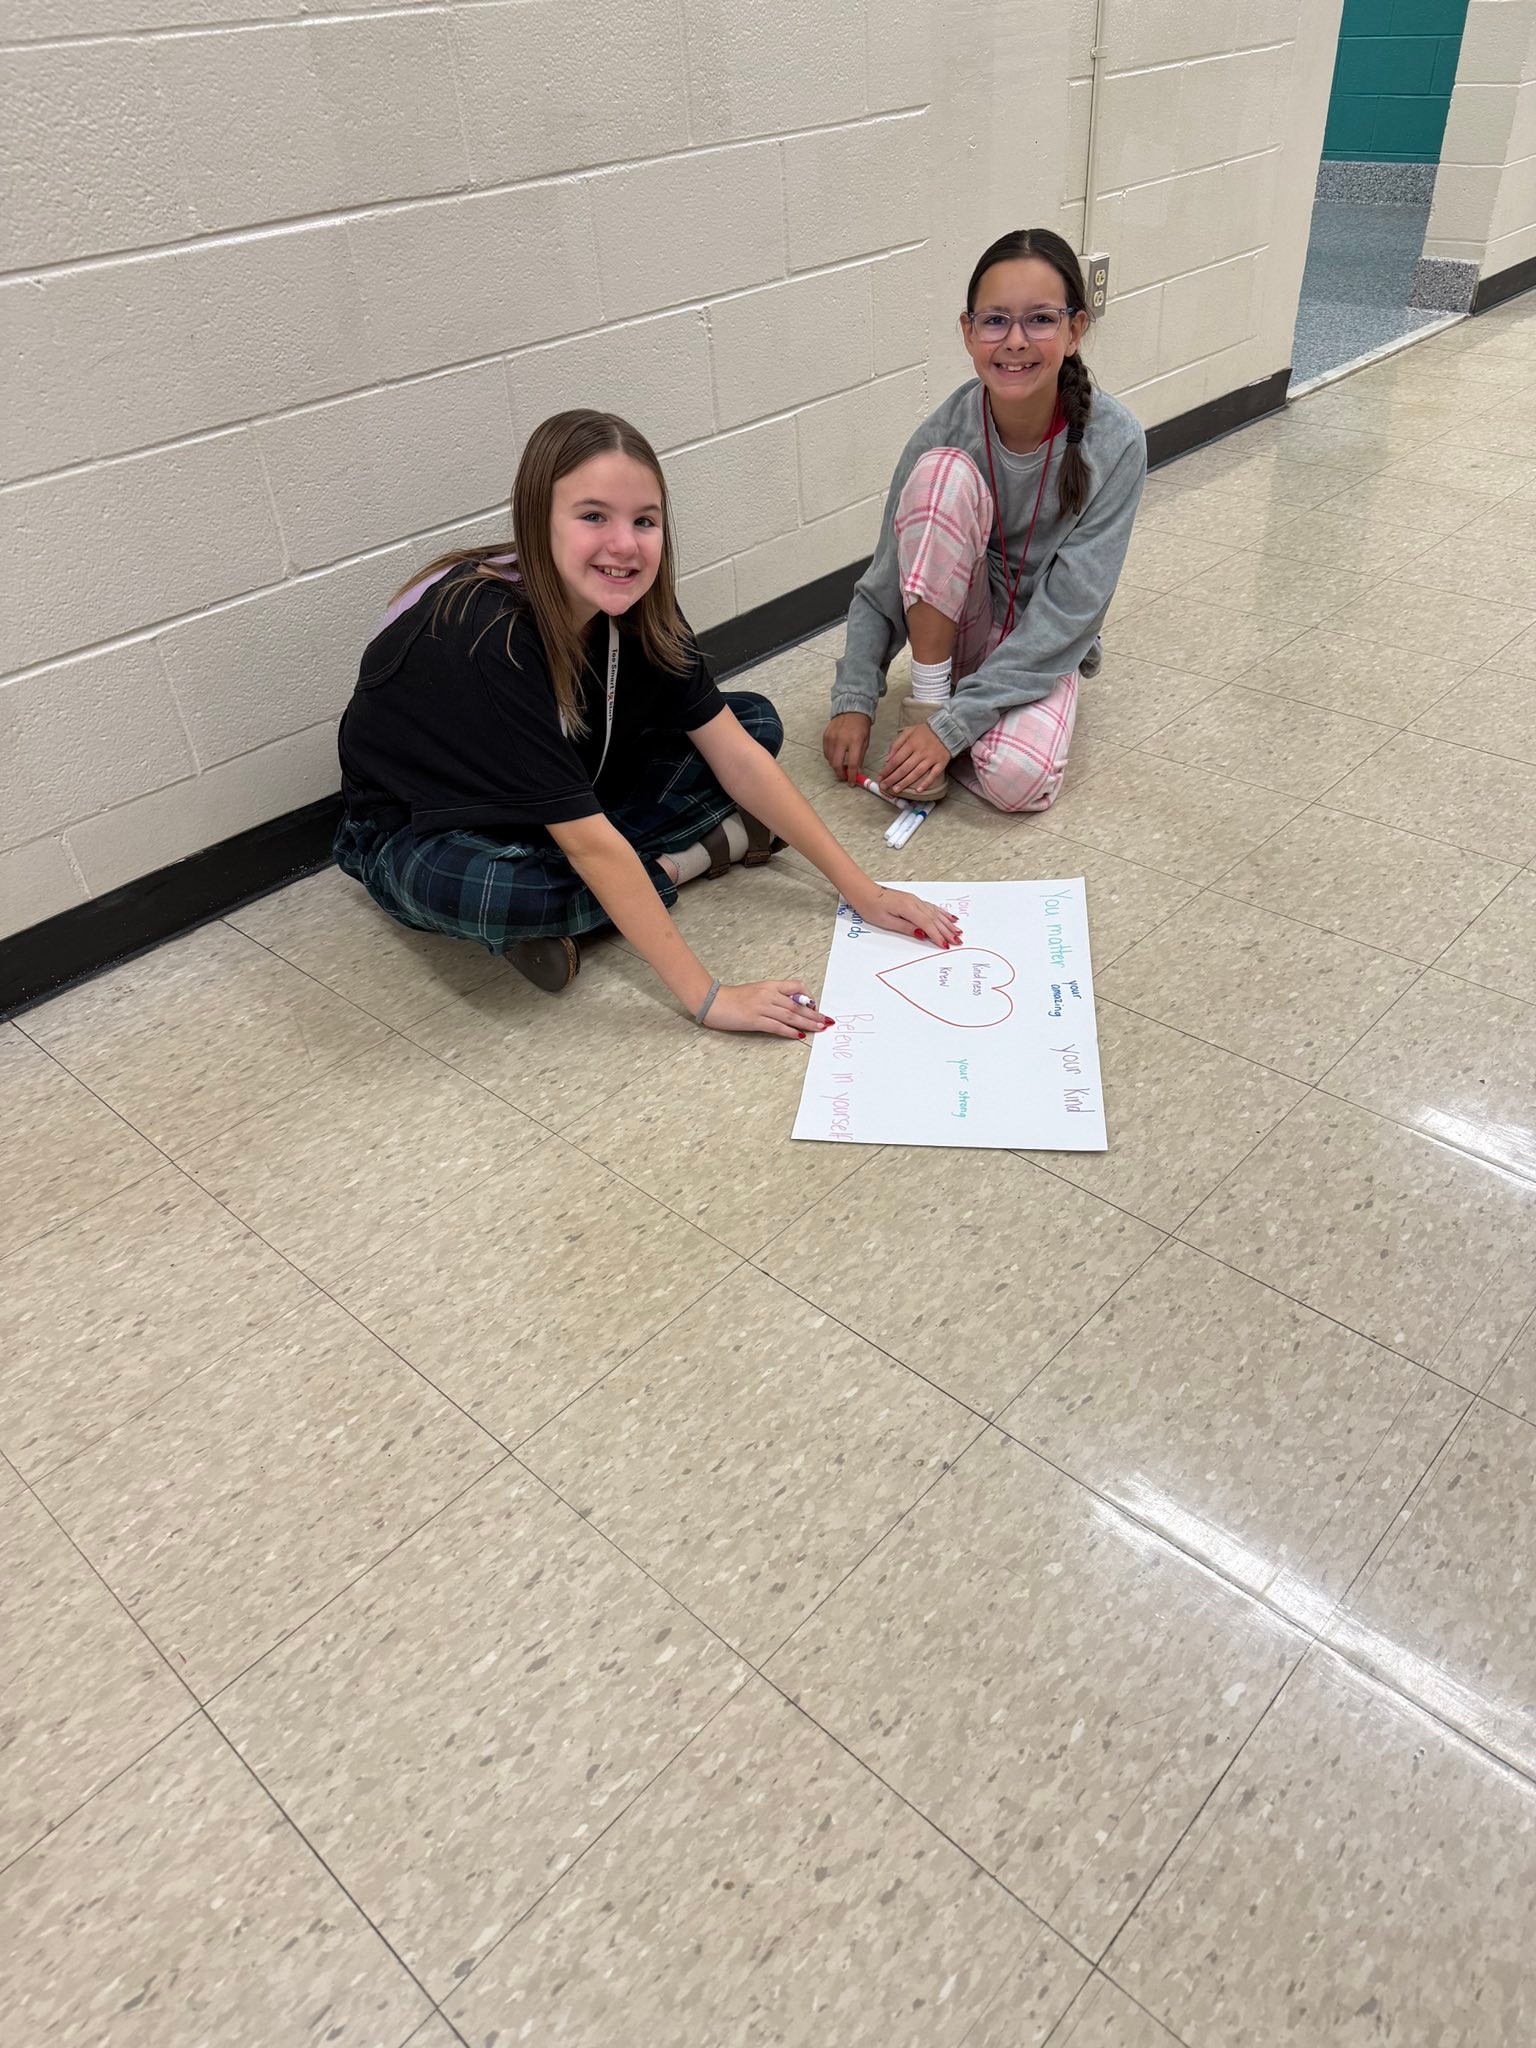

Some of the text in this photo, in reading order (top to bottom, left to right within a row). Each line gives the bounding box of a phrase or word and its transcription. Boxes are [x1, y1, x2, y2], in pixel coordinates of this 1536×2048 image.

[609, 665, 617, 689] Smart
[847, 925, 871, 939] do
[1040, 889, 1072, 969] You matter
[1048, 983, 1063, 1018] amazing
[1062, 980, 1082, 1000] your
[1049, 1043, 1082, 1075] your
[819, 1013, 875, 1141] Beleive in yourself
[946, 1058, 971, 1118] your strong
